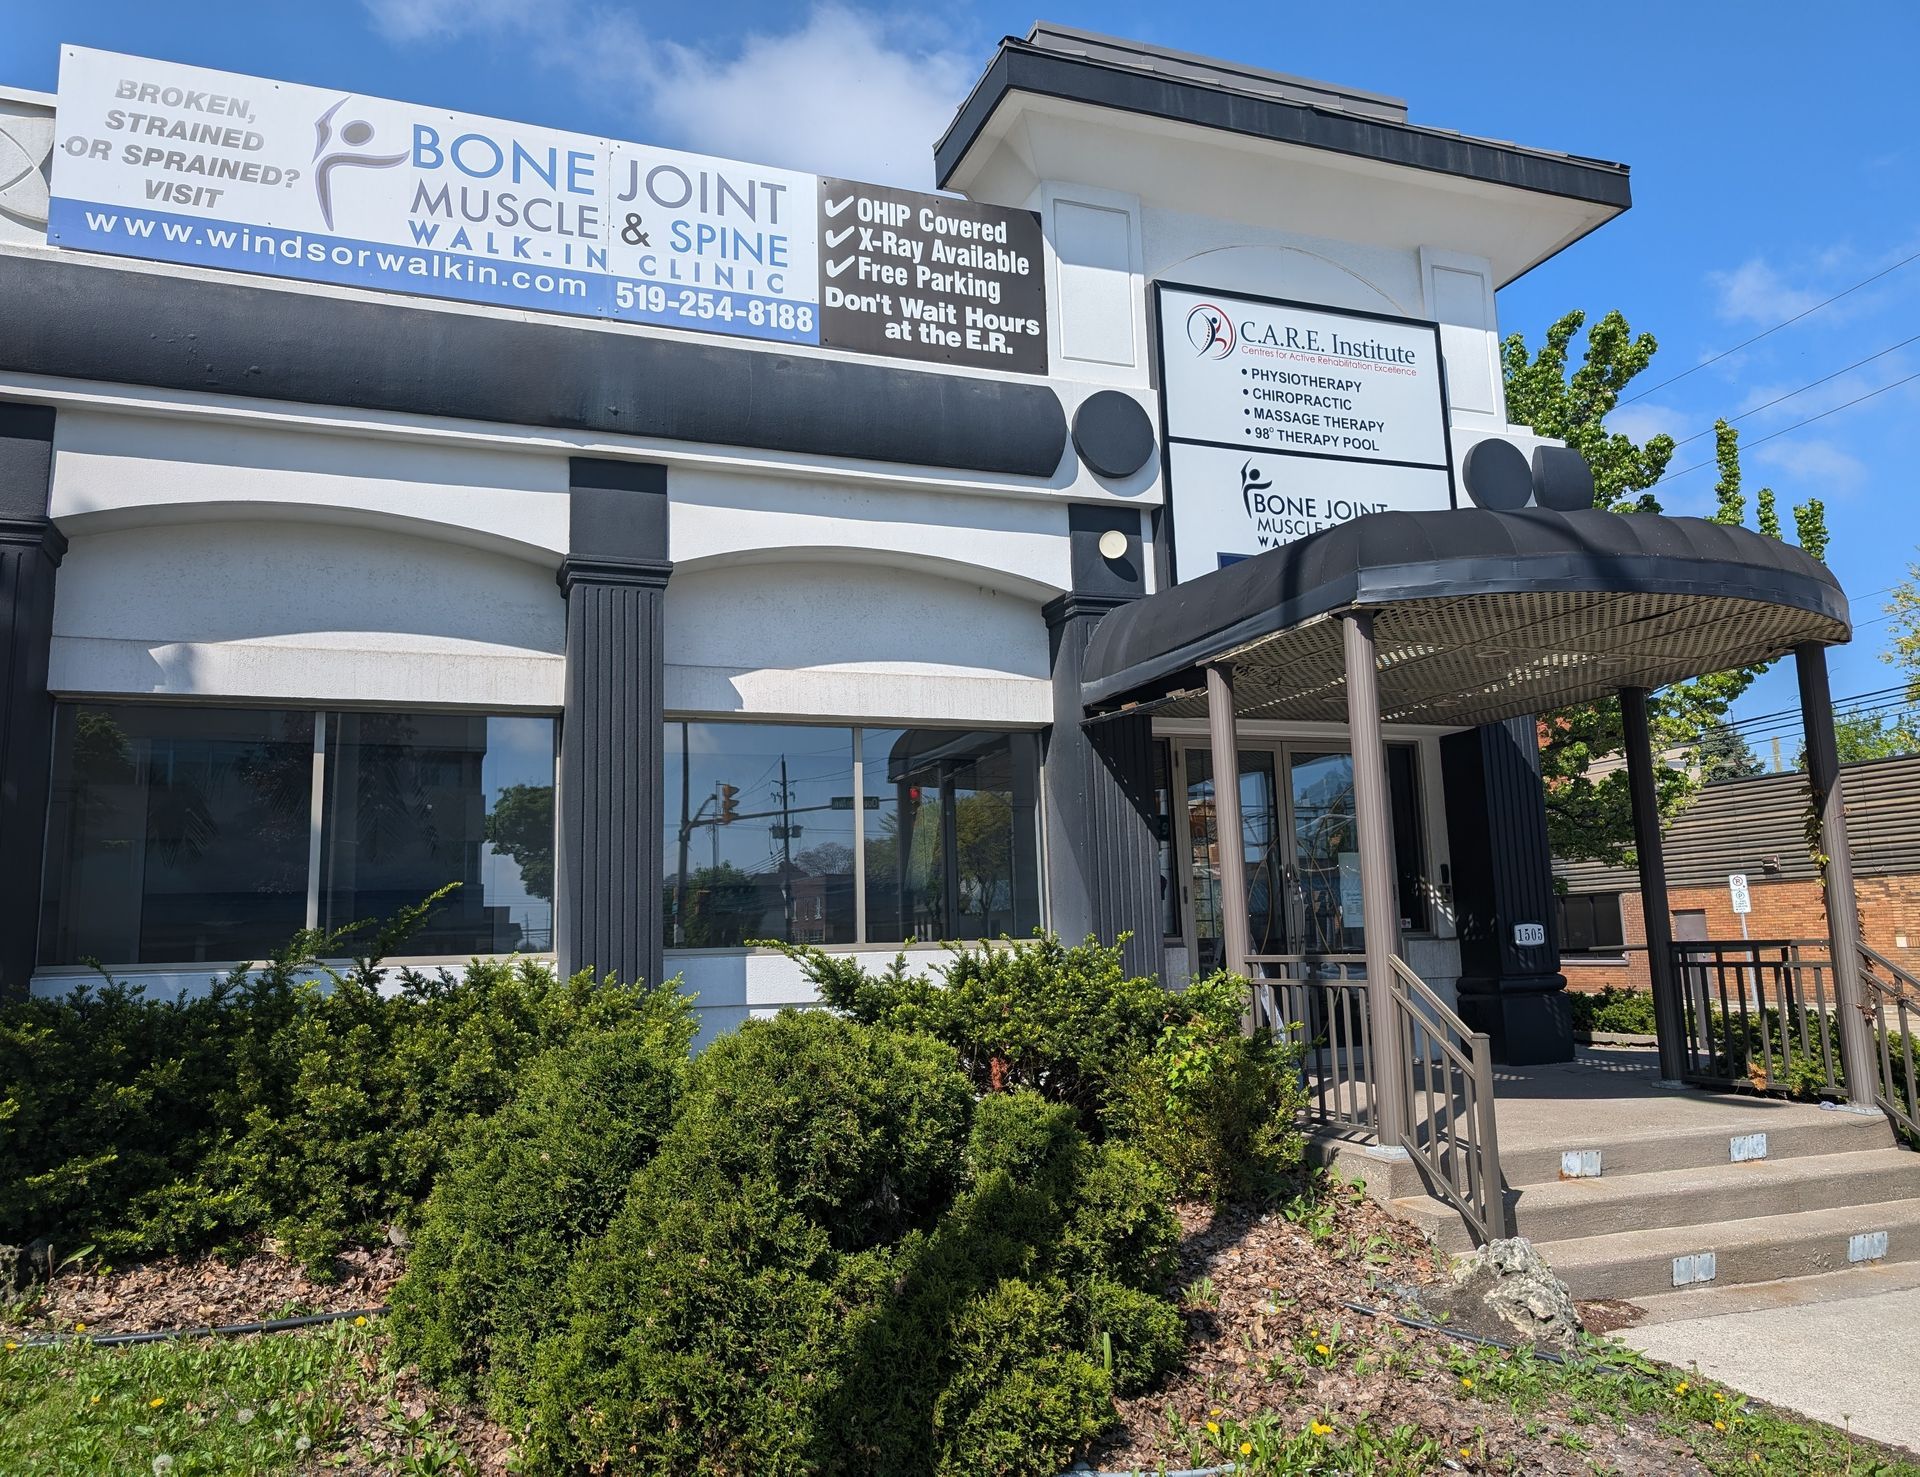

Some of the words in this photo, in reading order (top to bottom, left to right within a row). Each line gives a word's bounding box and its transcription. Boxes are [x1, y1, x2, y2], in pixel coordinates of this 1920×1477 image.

[115, 79, 256, 124] BROKEN,
[105, 110, 264, 151] STRAINED
[64, 136, 113, 160] OR
[122, 144, 300, 189] SPRAINED?
[412, 123, 595, 196] BONE
[617, 159, 787, 224] JOINT
[144, 180, 224, 208] VISIT
[410, 178, 599, 239] MUSCLE
[621, 212, 652, 248] &
[670, 220, 788, 268] SPINE
[857, 198, 911, 228] OHIP
[919, 208, 1007, 244] Covered
[85, 211, 586, 297] www.windsorwalkin.com
[407, 219, 607, 272] WALK-IN
[638, 254, 784, 293] CLINIC
[858, 226, 923, 264] X-Ray
[931, 239, 1030, 276] Available
[858, 256, 908, 286] Free
[916, 265, 1001, 305] Parking
[616, 282, 813, 333] 519-254-8188
[825, 286, 892, 316] Don't
[899, 296, 957, 325] Wait
[965, 306, 1040, 336] Hours
[885, 320, 912, 341] at
[918, 322, 962, 348] the
[966, 329, 1014, 355] E.R.
[1240, 321, 1324, 353] C.A.R.E.
[1331, 333, 1416, 365] Institute
[1241, 345, 1275, 359] Centres
[1275, 349, 1287, 360] for
[1289, 351, 1316, 364] Active
[1317, 354, 1373, 372] Rehabilitation
[1374, 361, 1417, 377] Excellence
[1251, 368, 1362, 393] PHYSIOTHERAPY
[1252, 388, 1352, 411] CHIROPRACTIC
[1253, 407, 1320, 426] MASSAGE
[1324, 415, 1385, 433] THERAPY
[1277, 429, 1339, 448] THERAPY
[1343, 437, 1380, 452] POOL
[1254, 493, 1317, 518] BONE
[1518, 928, 1543, 942] 1505
